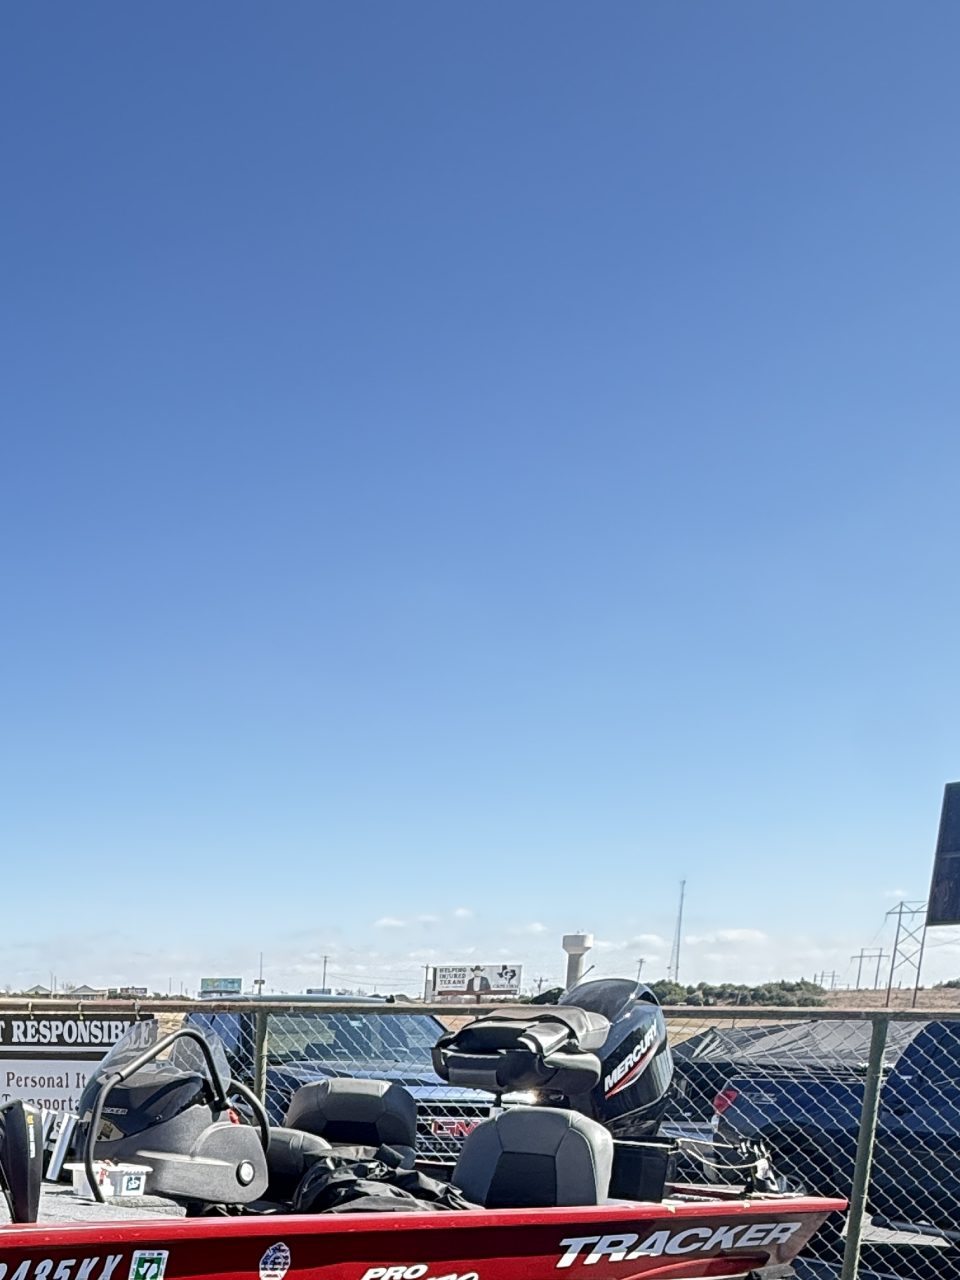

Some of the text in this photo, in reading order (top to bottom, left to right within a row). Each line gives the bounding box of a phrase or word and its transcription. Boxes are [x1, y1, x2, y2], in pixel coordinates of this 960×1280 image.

[604, 1019, 657, 1092] MERCURY
[6, 1072, 69, 1088] Personal
[431, 1119, 481, 1137] GM
[556, 1221, 803, 1268] TRACKER
